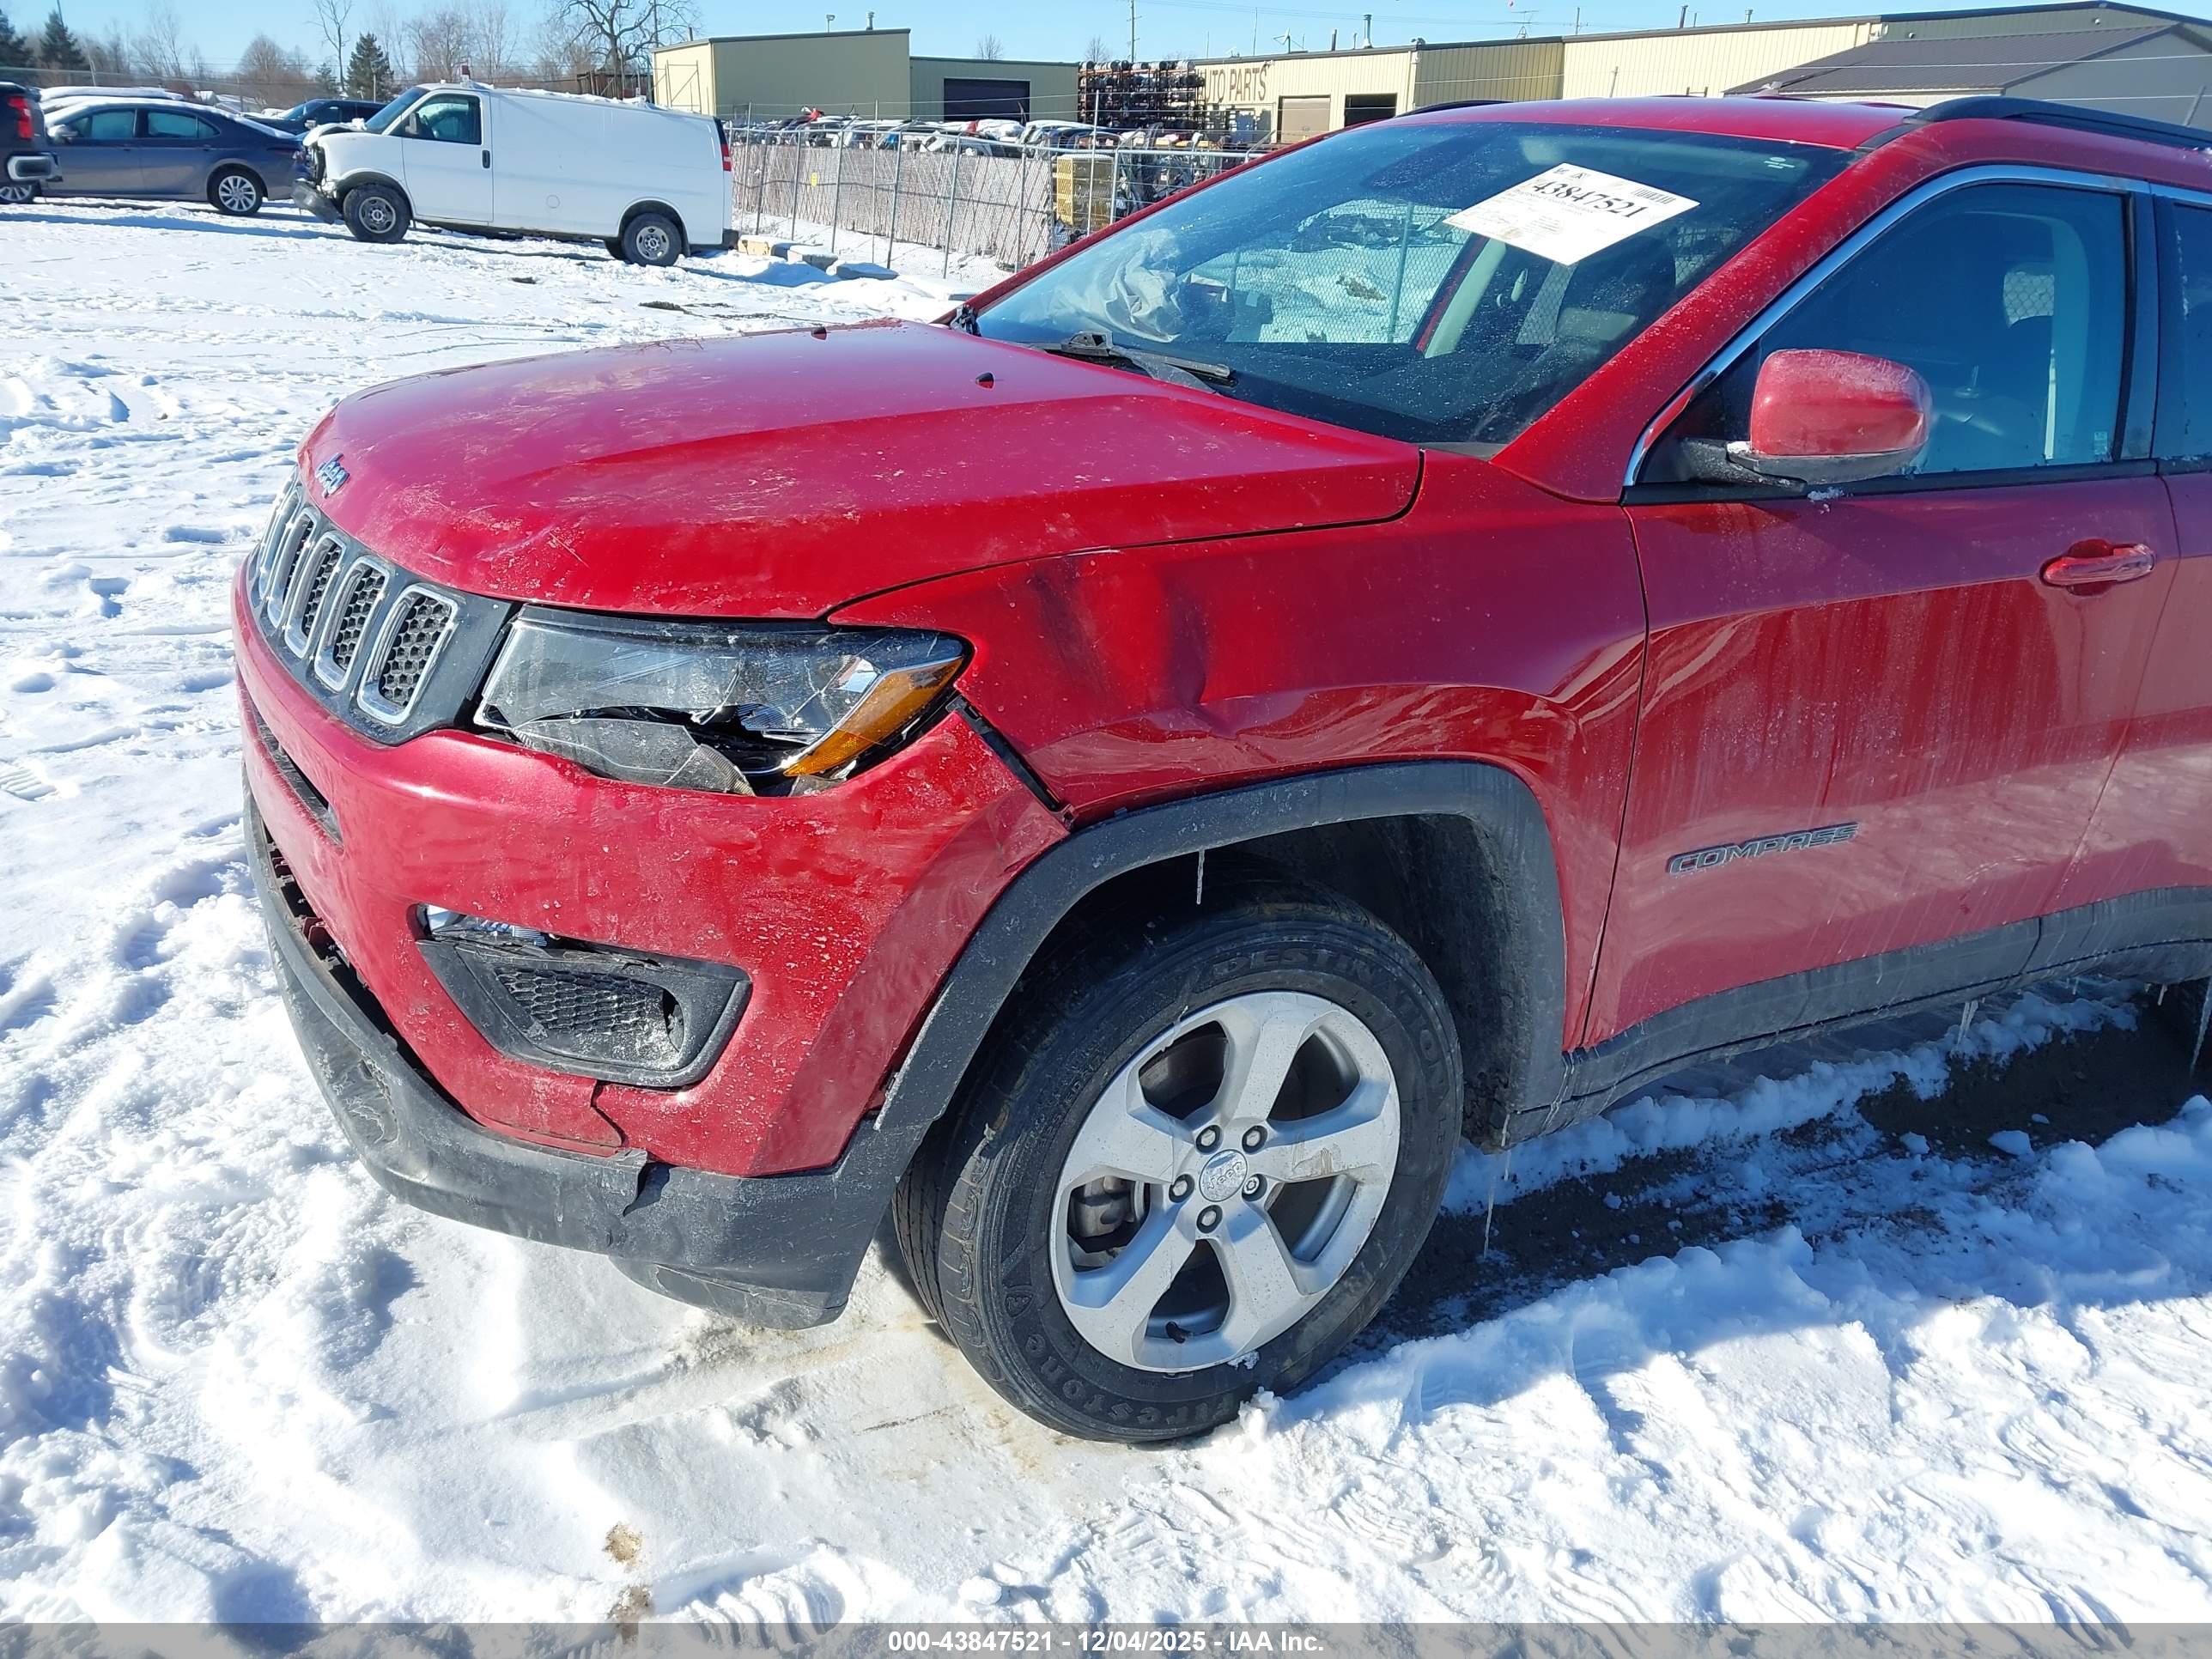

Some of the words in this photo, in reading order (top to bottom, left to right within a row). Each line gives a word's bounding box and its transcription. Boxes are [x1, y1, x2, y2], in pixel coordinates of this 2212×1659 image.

[1229, 65, 1267, 102] PARTS
[1532, 180, 1649, 218] 43847521
[1666, 822, 1859, 874] COMPASS
[1206, 1161, 1243, 1190] Jeep
